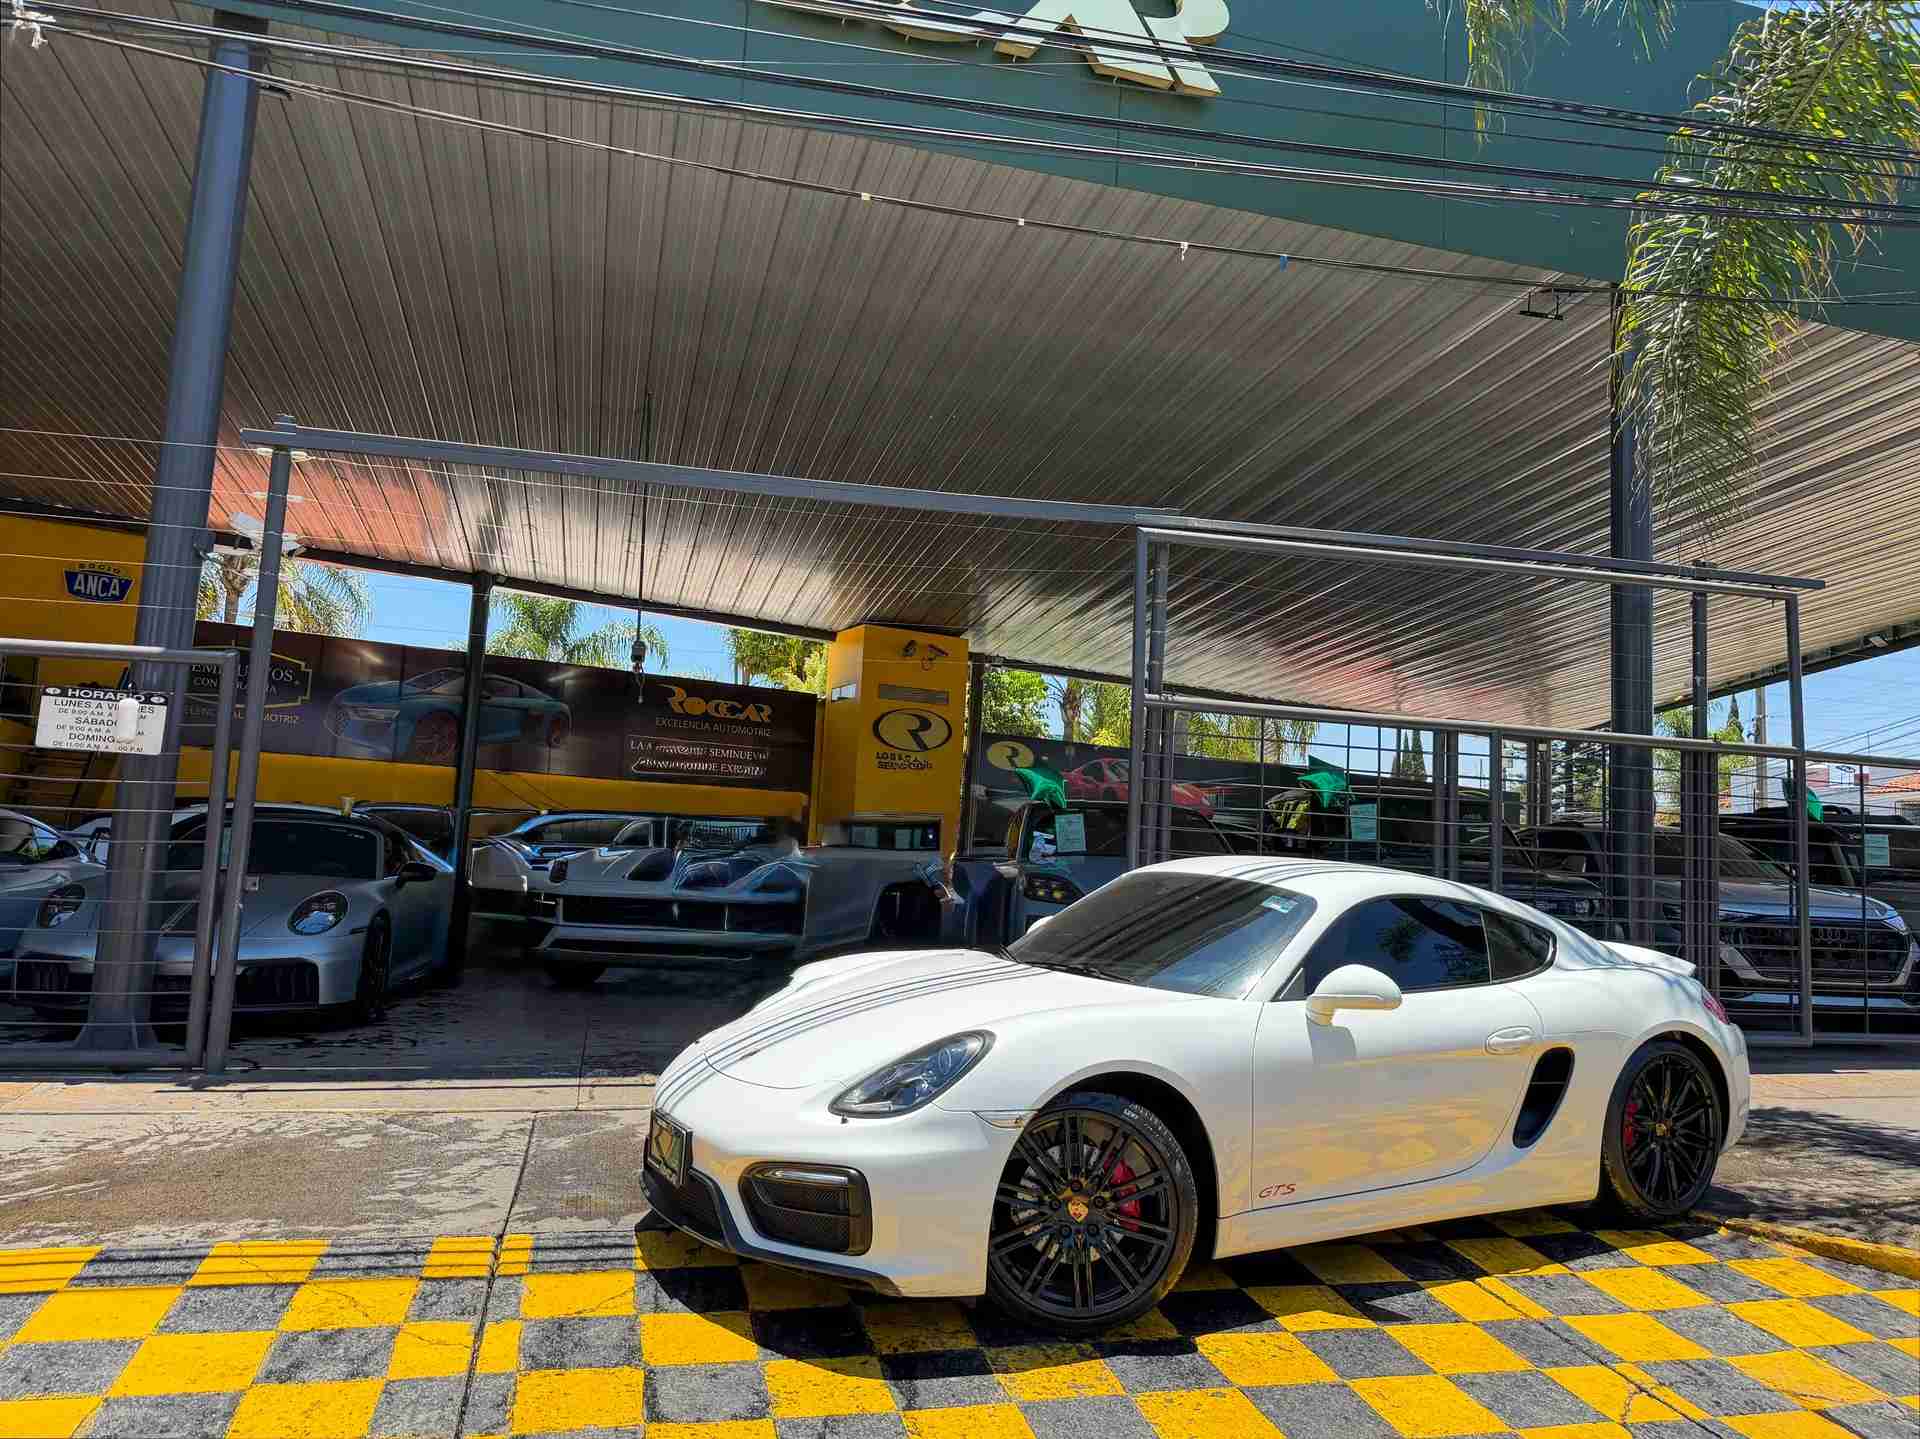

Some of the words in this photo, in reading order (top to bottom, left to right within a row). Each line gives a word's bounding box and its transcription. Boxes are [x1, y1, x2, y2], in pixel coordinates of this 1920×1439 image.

[73, 573, 120, 597] ANCA
[54, 699, 91, 710] LUNES
[95, 702, 102, 710] A
[655, 684, 772, 722] ROCCAR
[656, 717, 710, 732] EXCELENCIA
[713, 723, 772, 737] AUTOMOTRIZ
[1259, 1183, 1297, 1198] GTS
